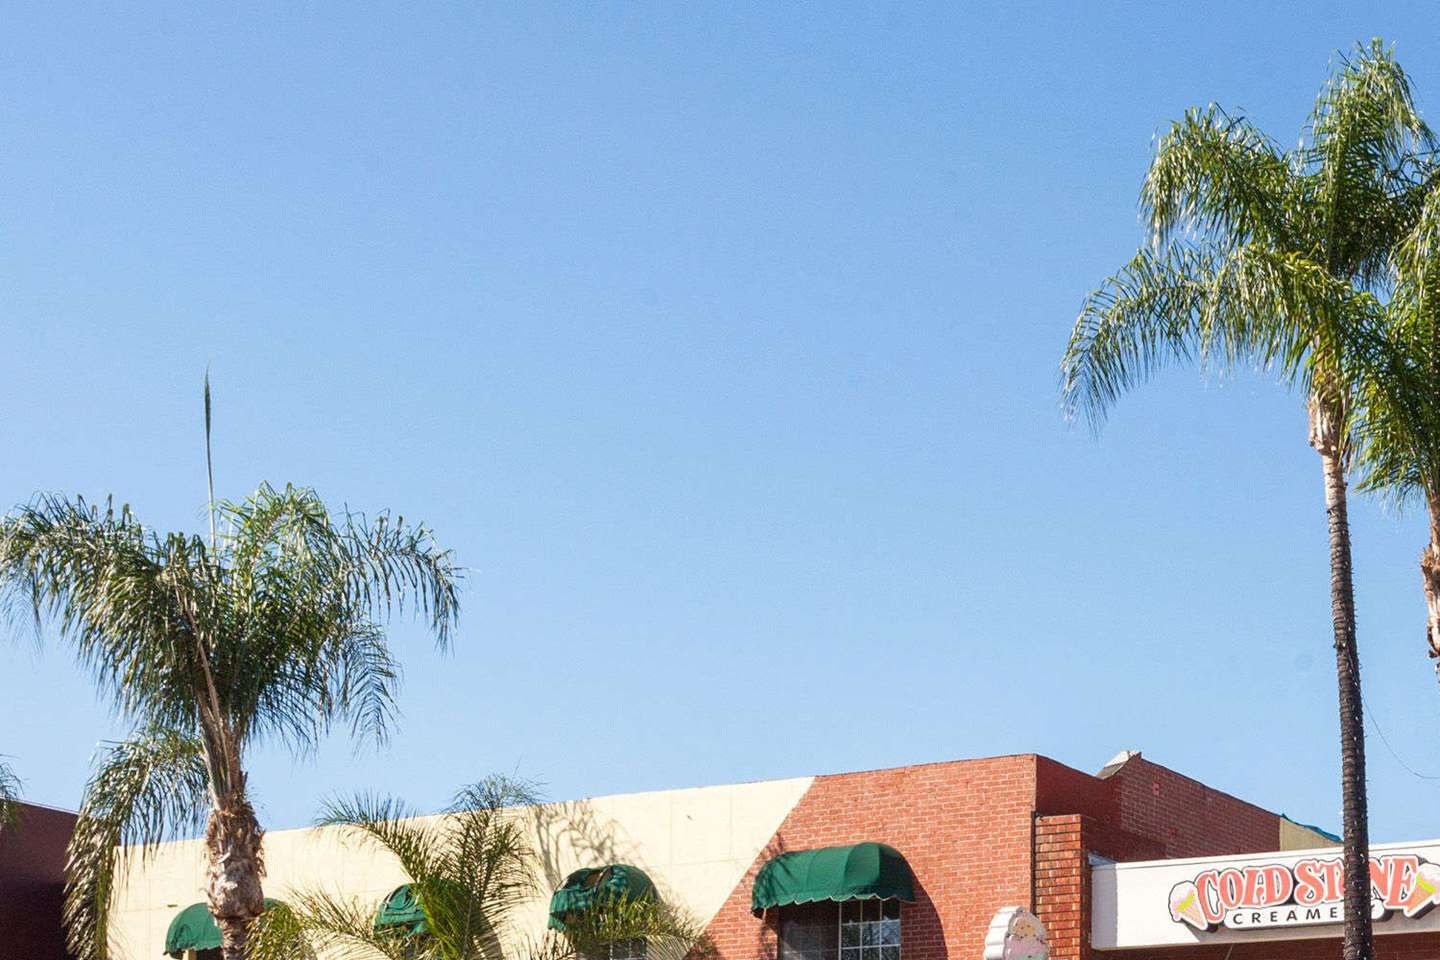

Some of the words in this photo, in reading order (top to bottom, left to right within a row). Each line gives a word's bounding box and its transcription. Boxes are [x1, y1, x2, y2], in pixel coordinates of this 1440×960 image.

[1196, 866, 1291, 923] COLD
[1295, 857, 1418, 907] STNE
[1233, 905, 1376, 925] CREAME
